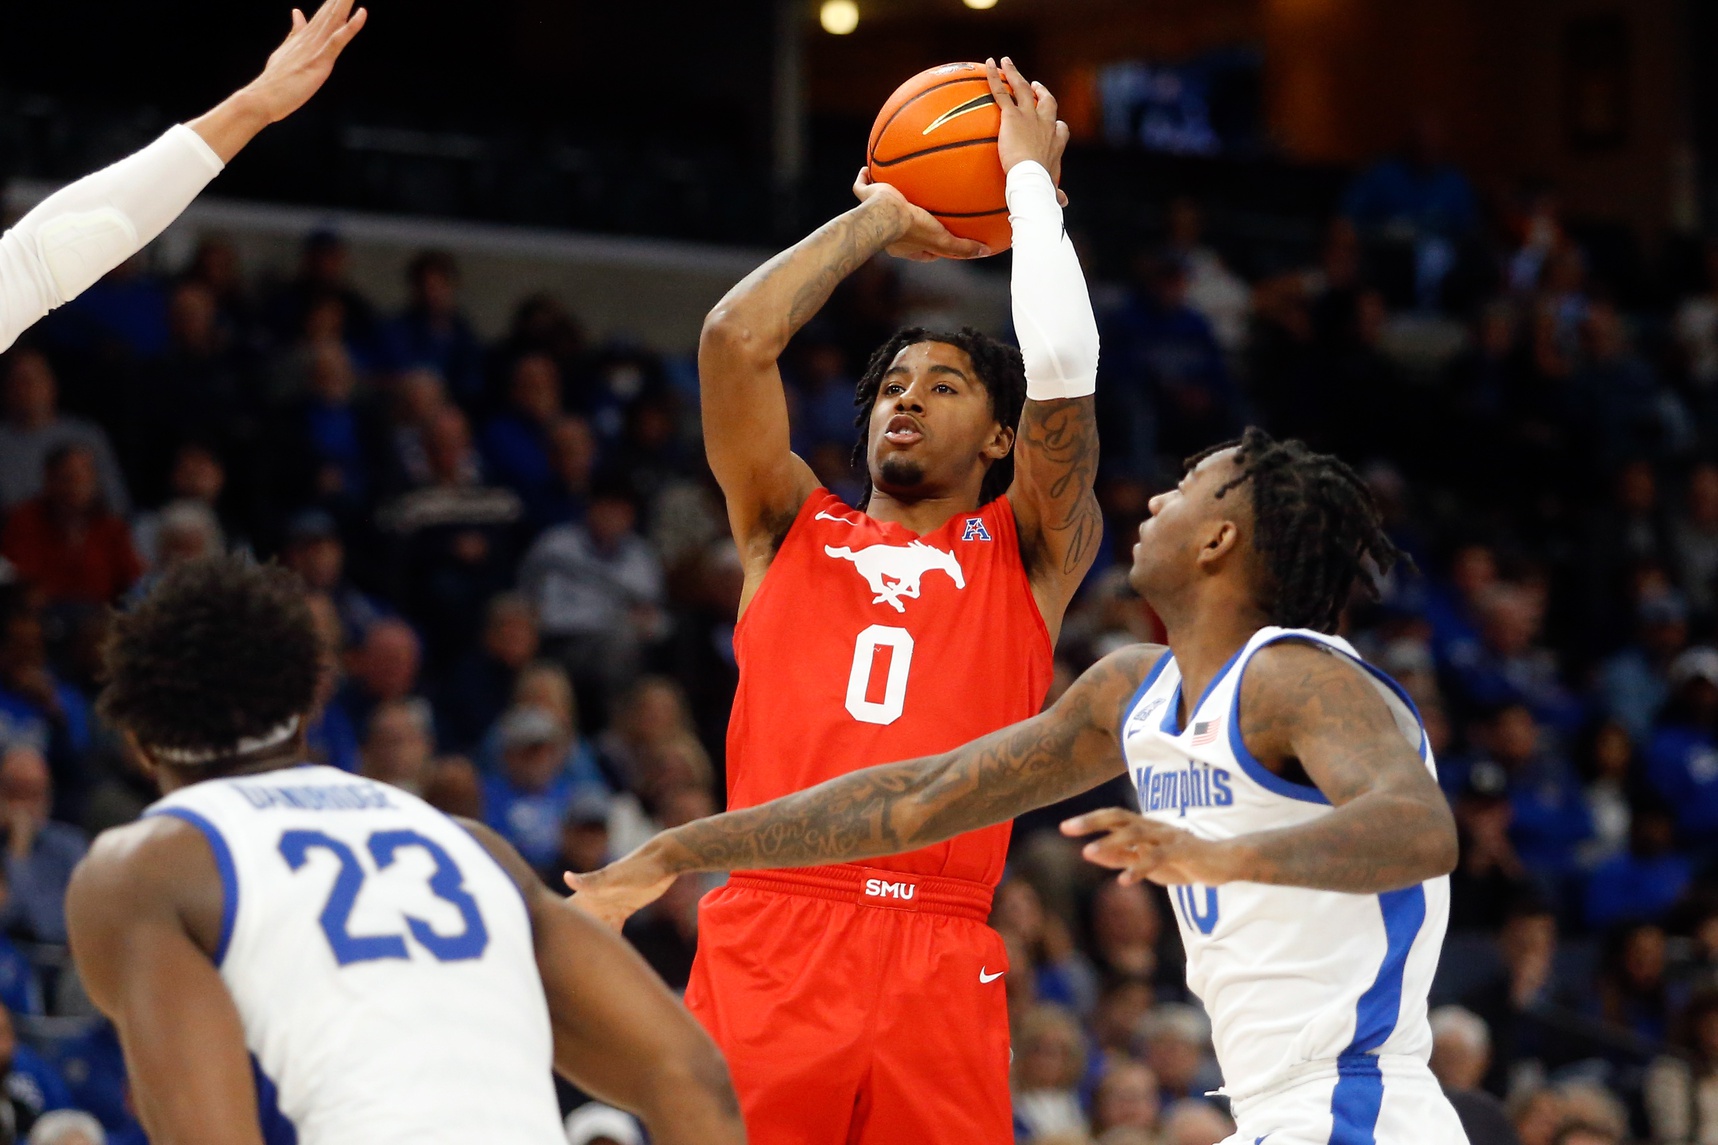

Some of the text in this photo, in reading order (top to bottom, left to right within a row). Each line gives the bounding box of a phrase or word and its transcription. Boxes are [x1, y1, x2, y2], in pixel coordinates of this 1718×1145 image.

[844, 623, 915, 726] 0
[1136, 759, 1234, 818] Memphis
[277, 828, 490, 968] 23
[865, 878, 916, 900] SMU
